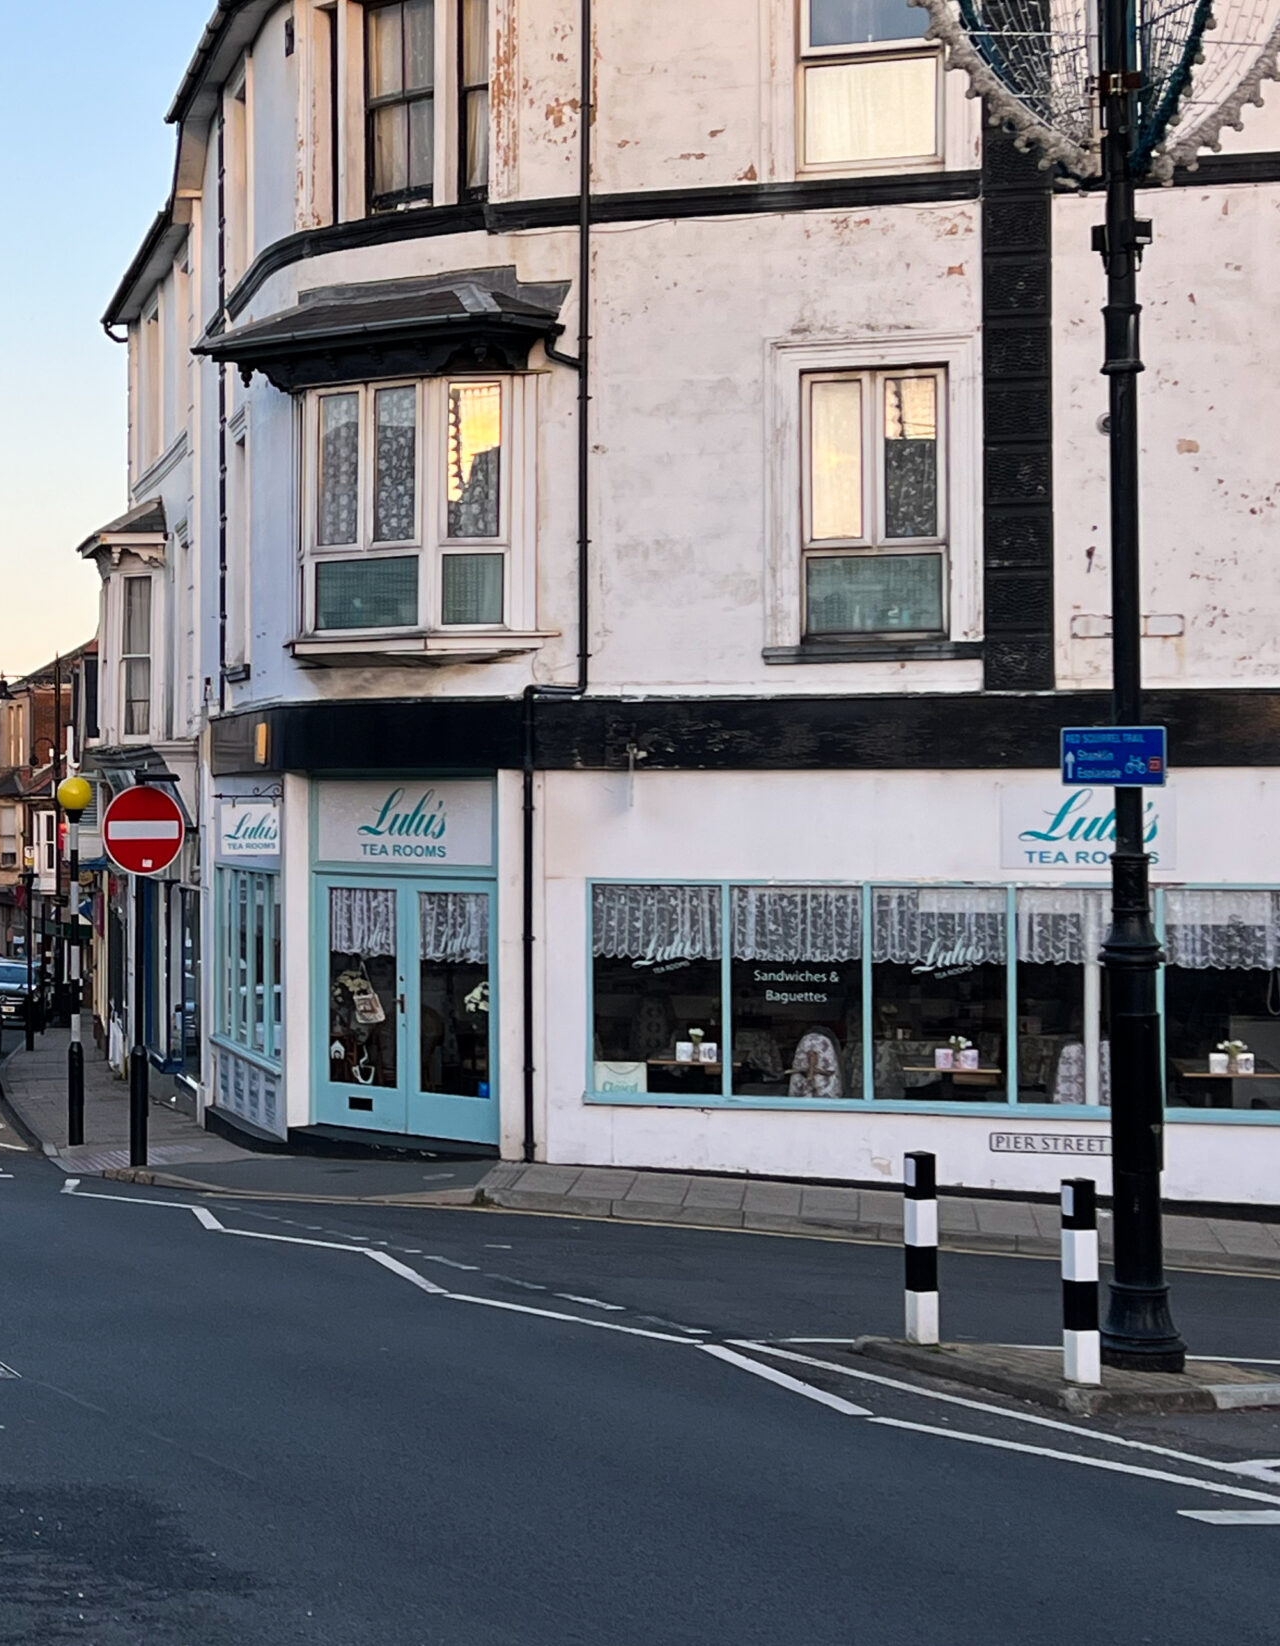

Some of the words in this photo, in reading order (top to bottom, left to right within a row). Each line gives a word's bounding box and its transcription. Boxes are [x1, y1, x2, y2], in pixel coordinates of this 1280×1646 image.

[356, 787, 447, 839] Lulu's
[223, 811, 278, 840] Lulu's
[361, 843, 389, 856] TEA
[392, 844, 446, 858] ROOMS
[1025, 850, 1068, 864] TEA
[1075, 851, 1159, 864] ROS
[753, 969, 827, 982] Sandwiches
[829, 971, 839, 982] &
[765, 989, 828, 1004] Baguettes
[996, 1135, 1036, 1150] PIER
[1041, 1137, 1105, 1152] STREET
